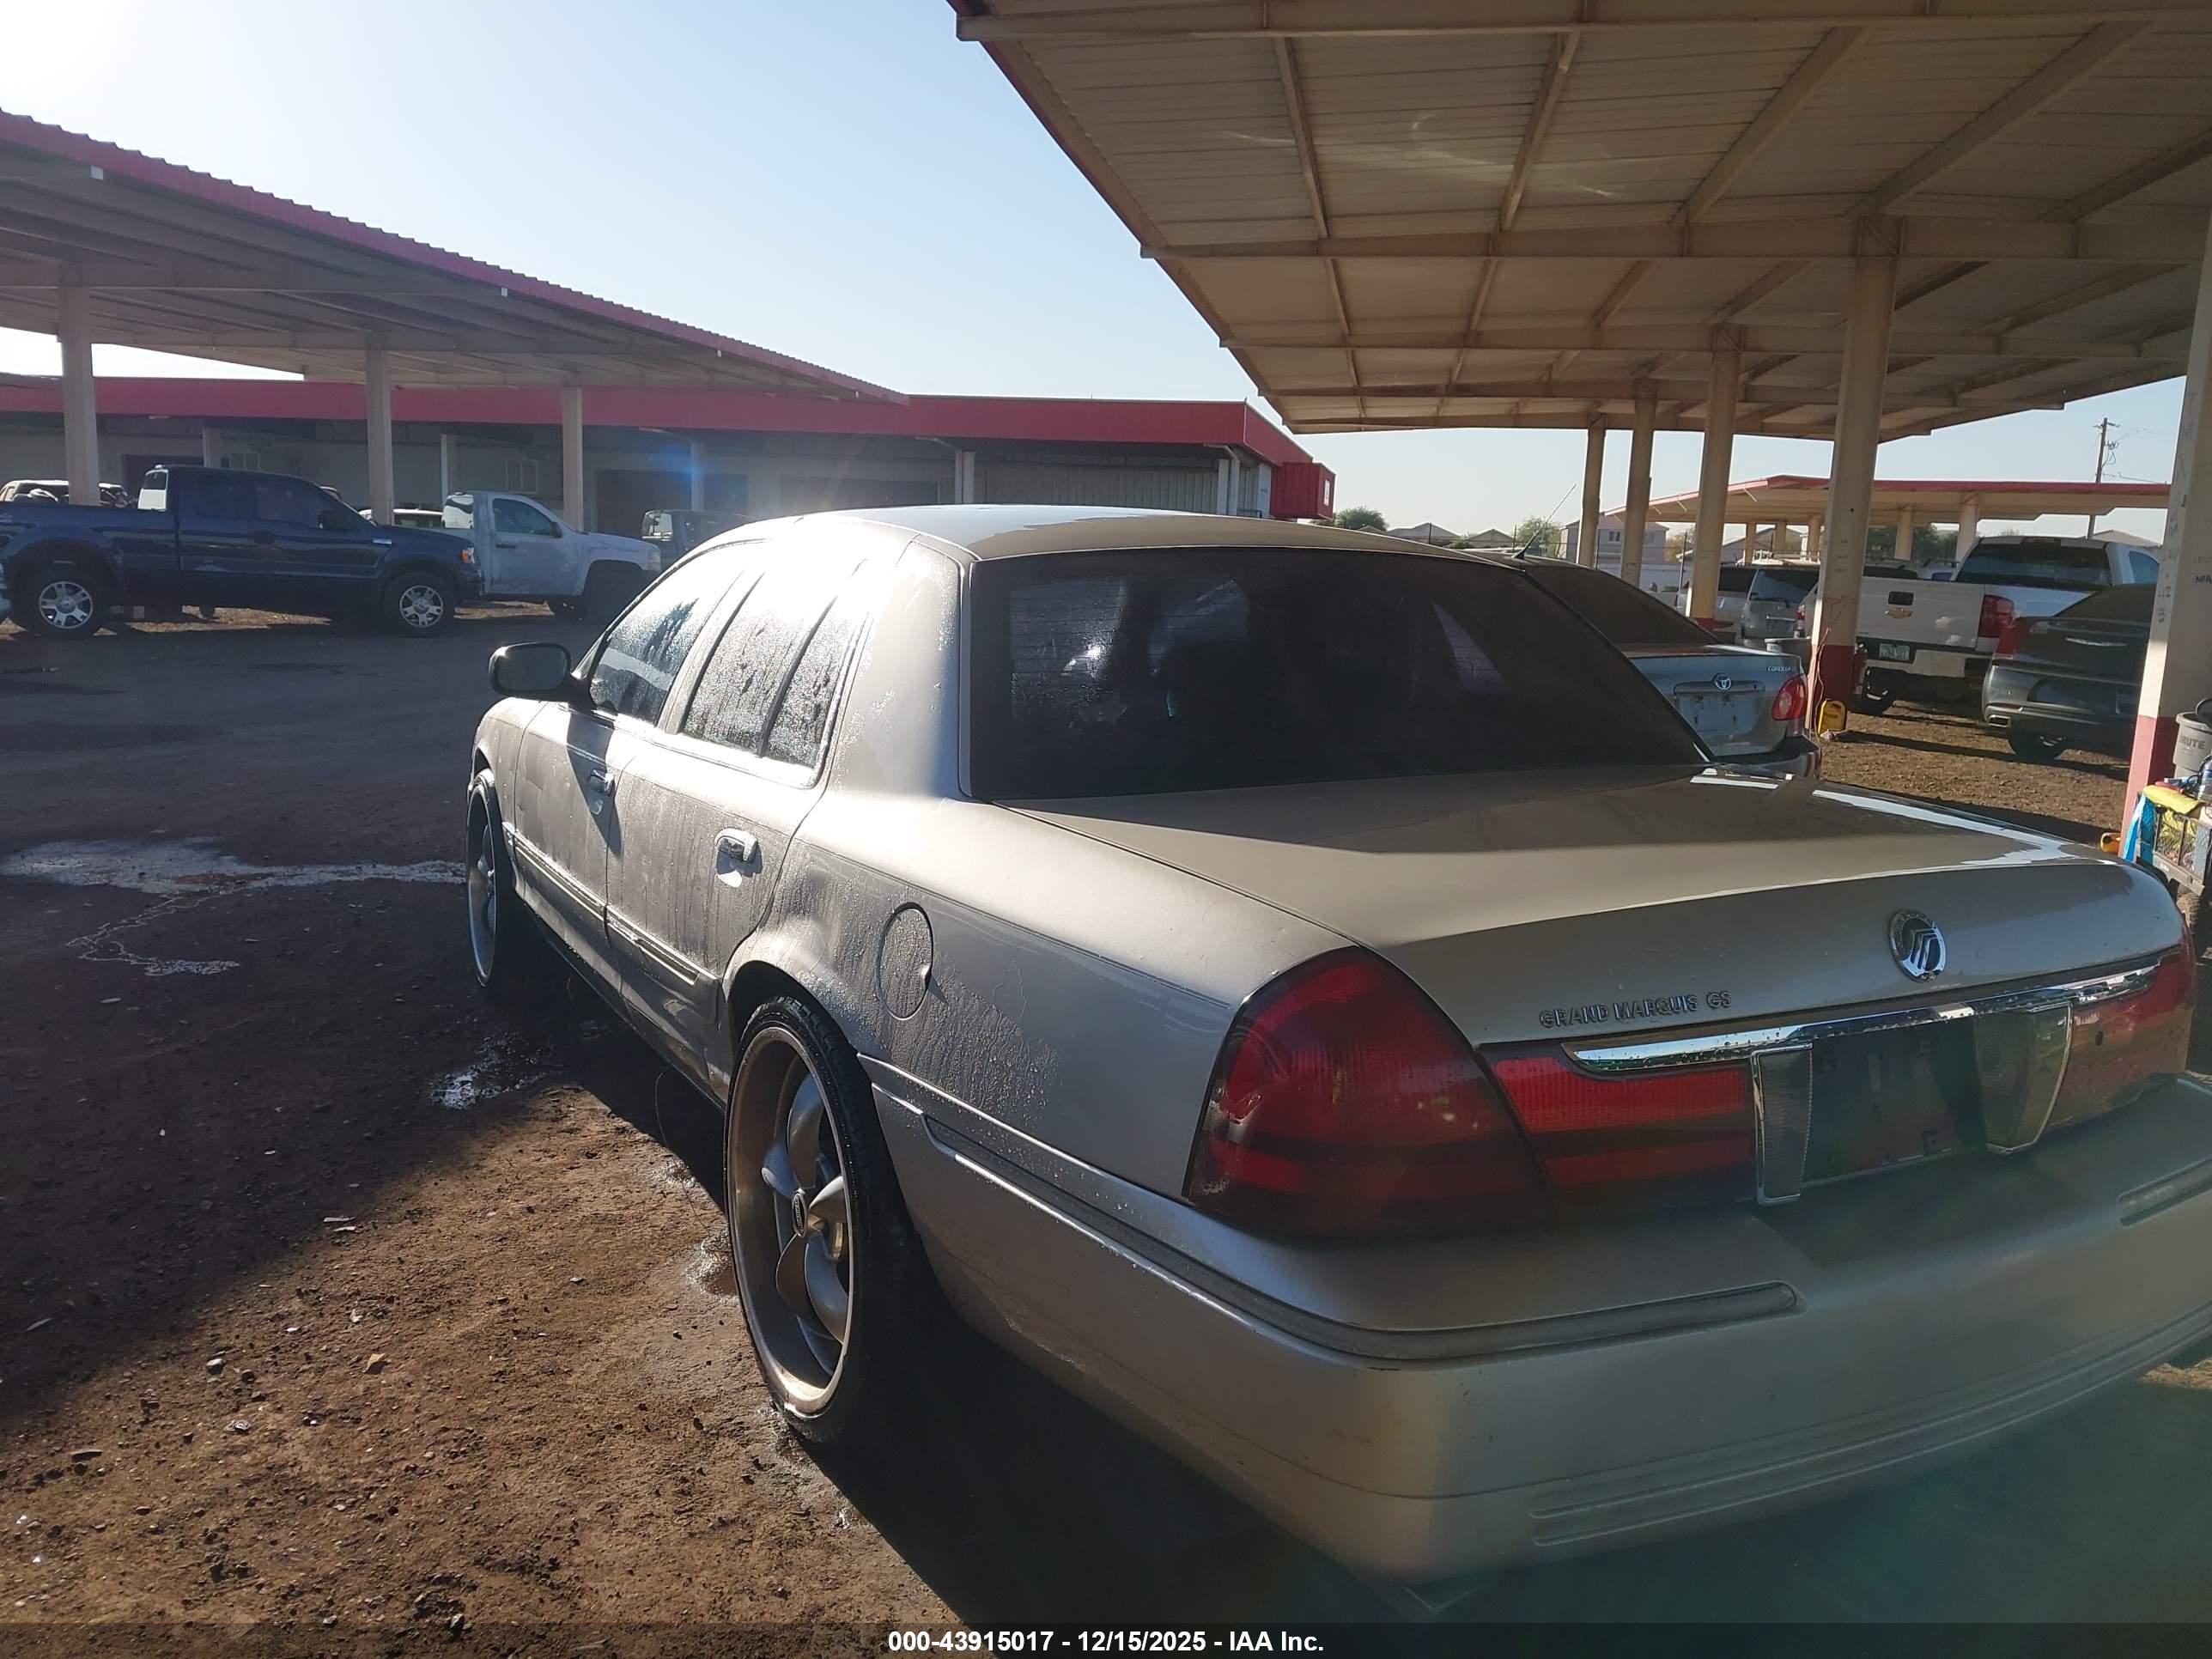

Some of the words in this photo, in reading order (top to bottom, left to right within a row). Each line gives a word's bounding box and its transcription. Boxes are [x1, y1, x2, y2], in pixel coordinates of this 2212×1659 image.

[1540, 1004, 1609, 1028] GRAND
[1613, 994, 1698, 1019] MARQUIS
[1706, 990, 1732, 1010] GS
